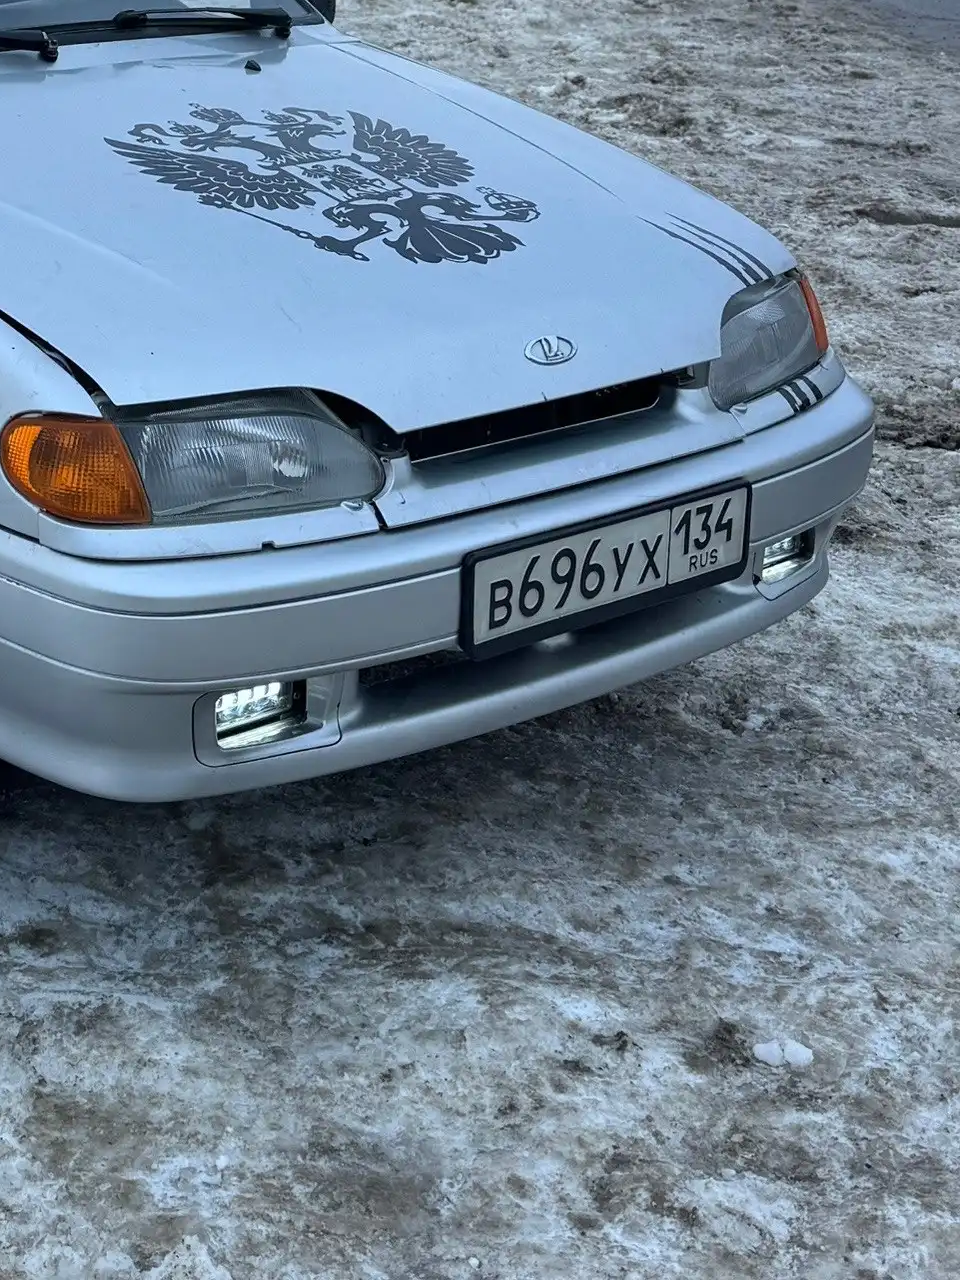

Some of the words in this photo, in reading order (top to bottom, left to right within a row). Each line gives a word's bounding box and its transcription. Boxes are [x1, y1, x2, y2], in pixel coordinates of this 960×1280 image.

[489, 534, 663, 630] В696УХ
[674, 498, 733, 555] 134
[689, 549, 719, 572] RUS
